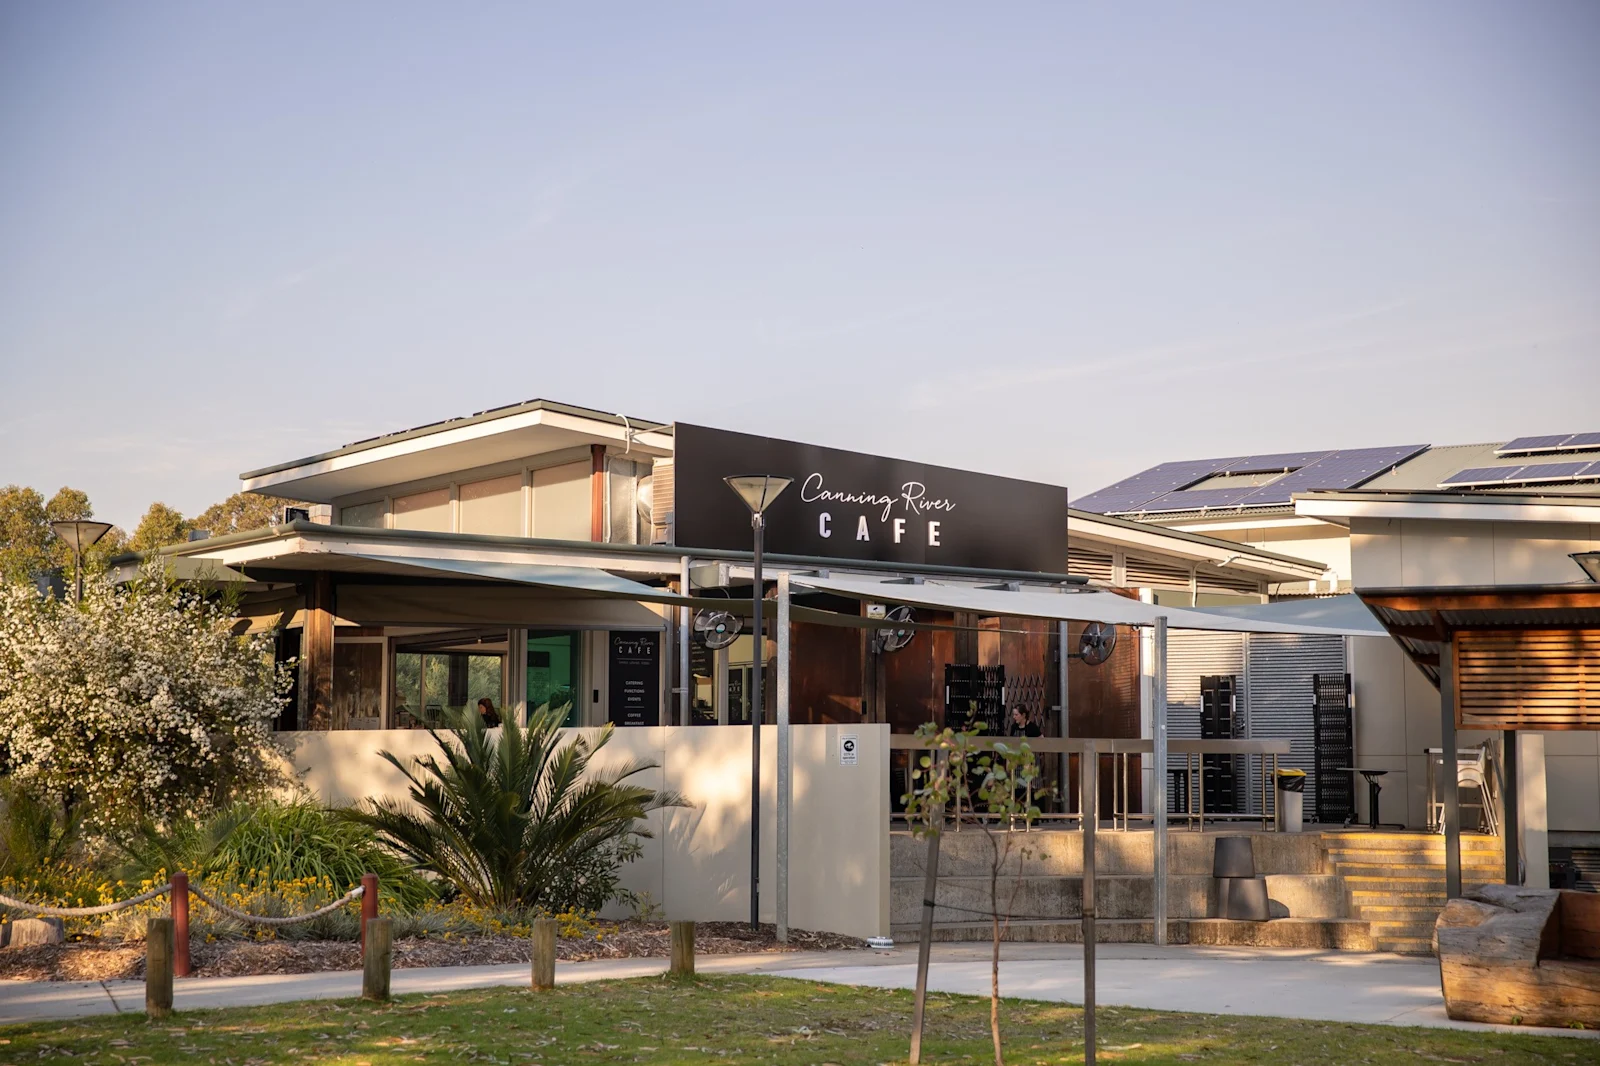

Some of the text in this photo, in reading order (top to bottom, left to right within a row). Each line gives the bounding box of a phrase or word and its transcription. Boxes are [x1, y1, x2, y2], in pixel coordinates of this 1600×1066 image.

[800, 472, 956, 522] Canning River
[818, 512, 941, 547] CAFE
[618, 646, 651, 654] CAFE
